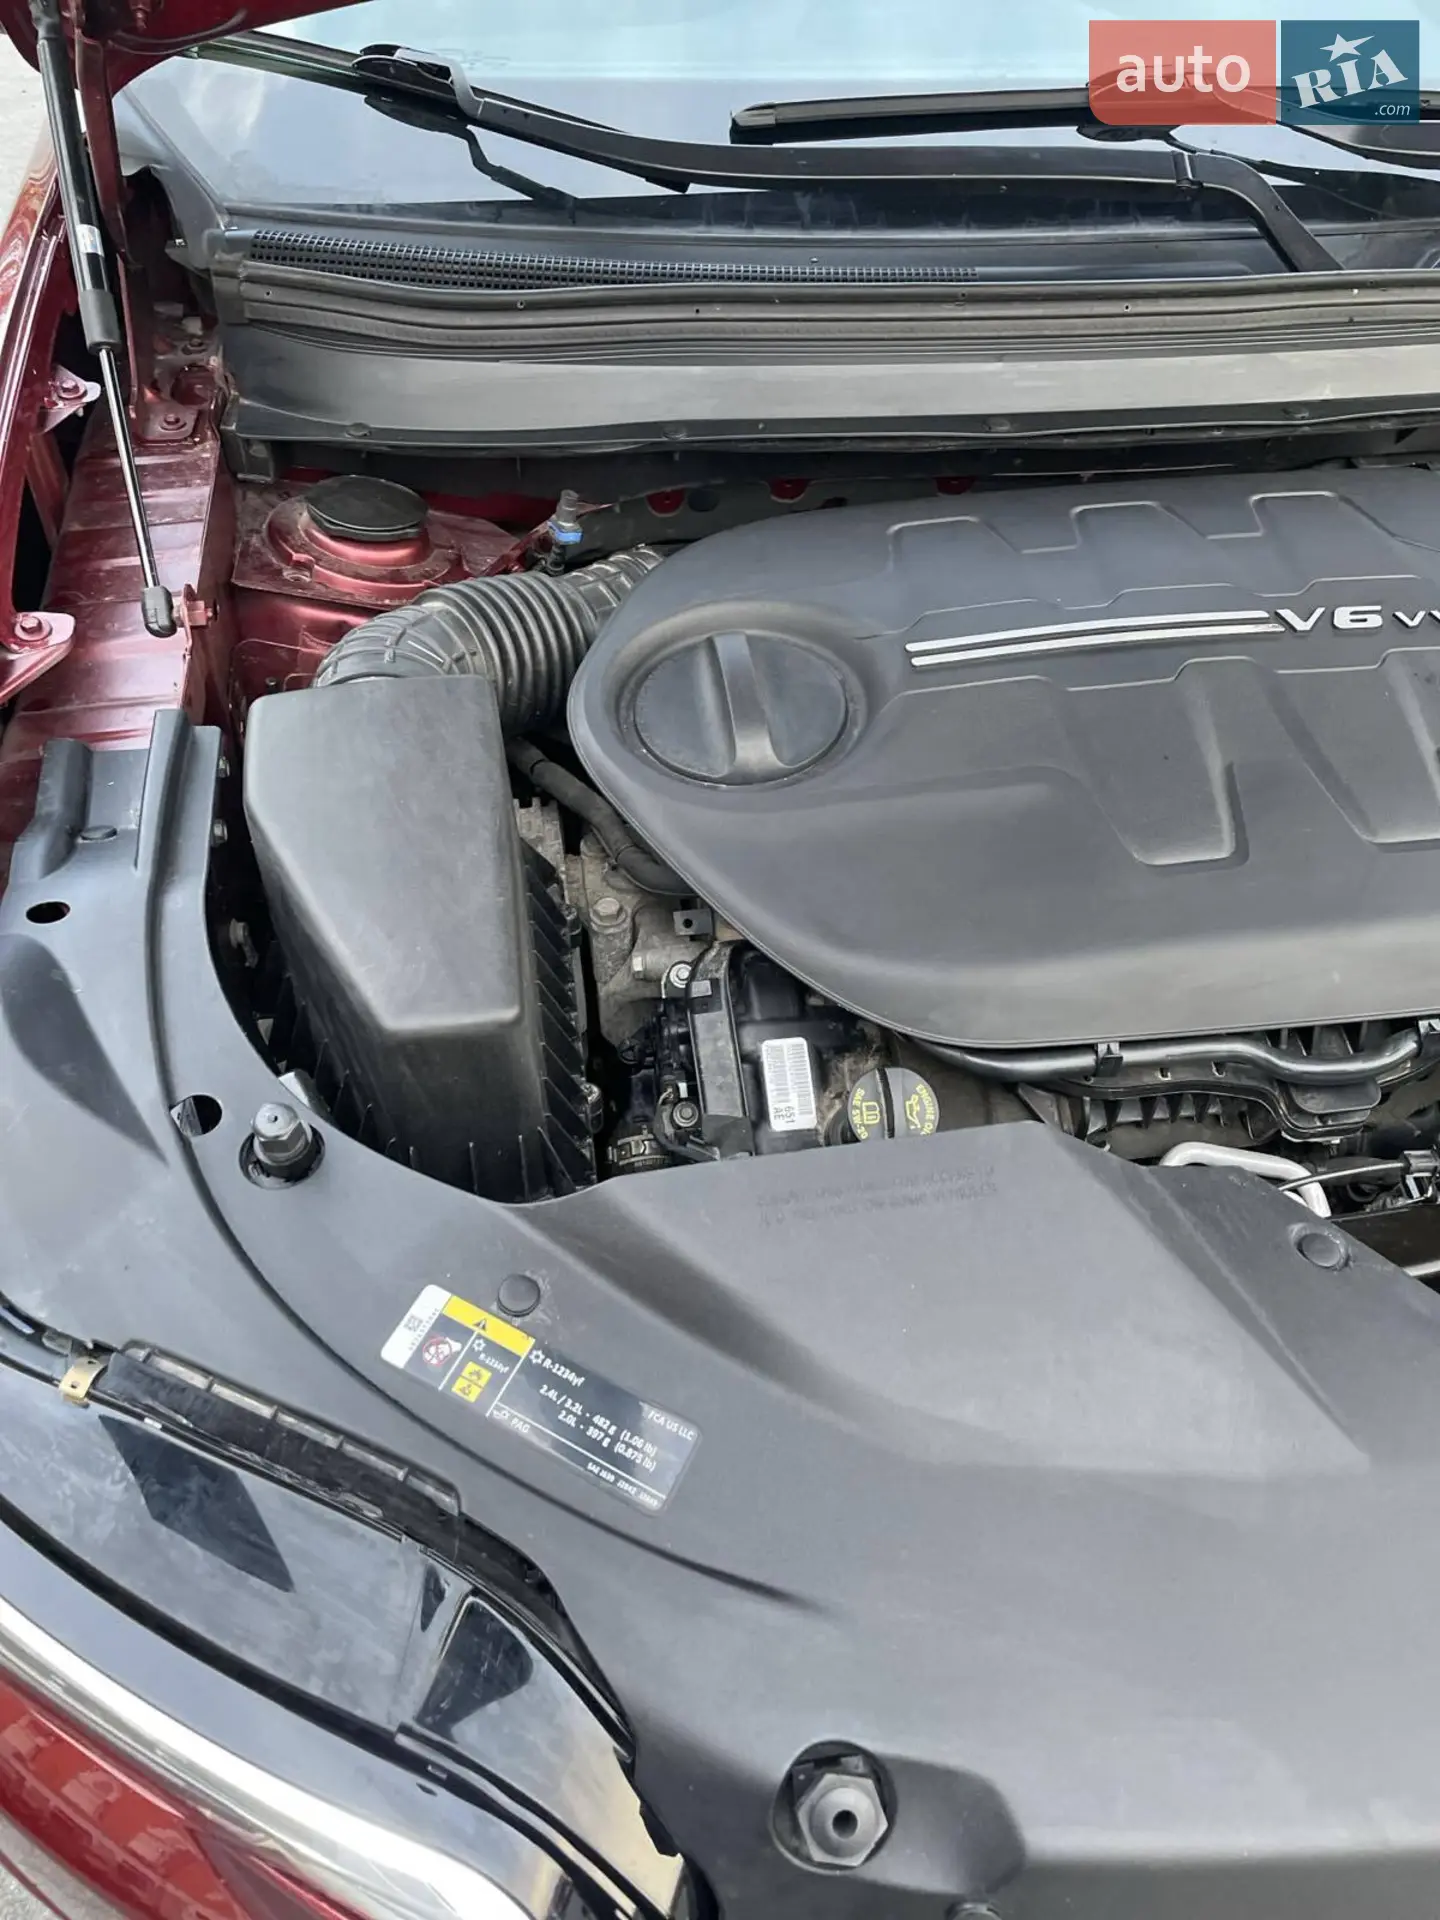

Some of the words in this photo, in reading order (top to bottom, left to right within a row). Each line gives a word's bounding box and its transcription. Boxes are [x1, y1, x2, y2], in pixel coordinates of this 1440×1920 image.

[1275, 605, 1383, 632] V6
[916, 1084, 935, 1120] ENGINE
[542, 1358, 585, 1387] R-1234yf
[540, 1384, 558, 1401] 2.4L
[564, 1398, 583, 1415] 3.2L
[558, 1410, 577, 1427] 2.0L
